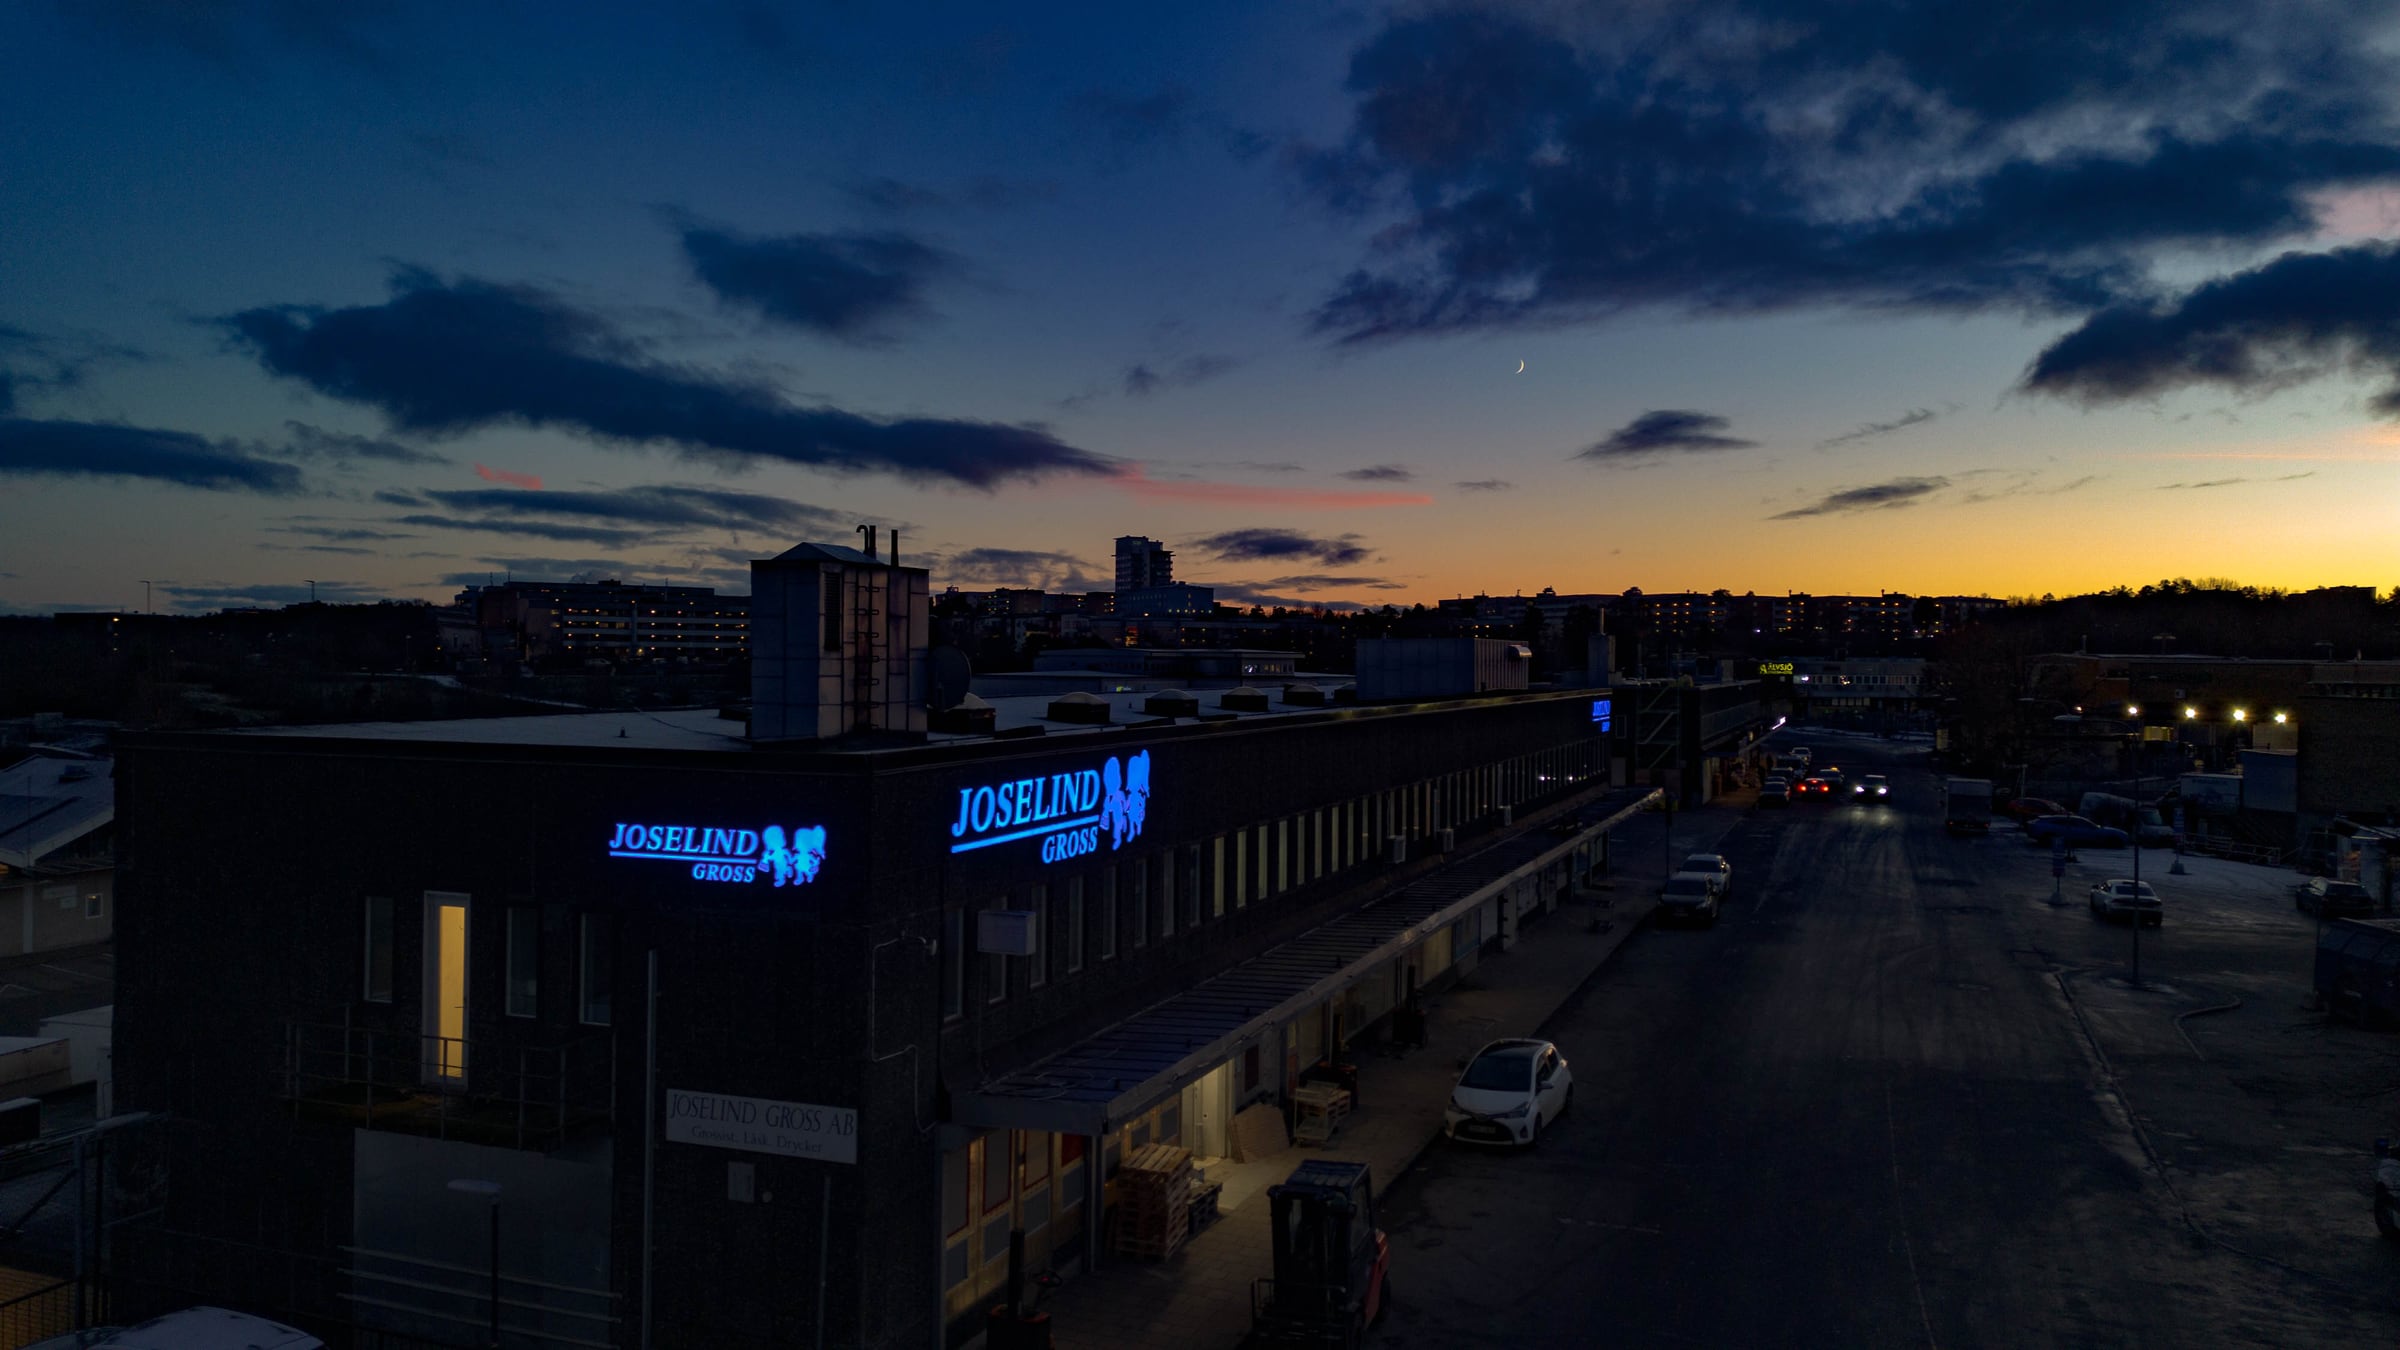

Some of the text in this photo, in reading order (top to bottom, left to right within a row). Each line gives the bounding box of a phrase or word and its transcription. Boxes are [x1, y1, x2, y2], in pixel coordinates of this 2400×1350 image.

[952, 769, 1100, 837] JOSELIND
[609, 823, 758, 855] JOSELIND
[1042, 826, 1098, 863] GROSS
[692, 863, 755, 883] GROSS
[671, 1094, 854, 1136] JOSELIND GROSS AB
[777, 1134, 823, 1153] Drycker
